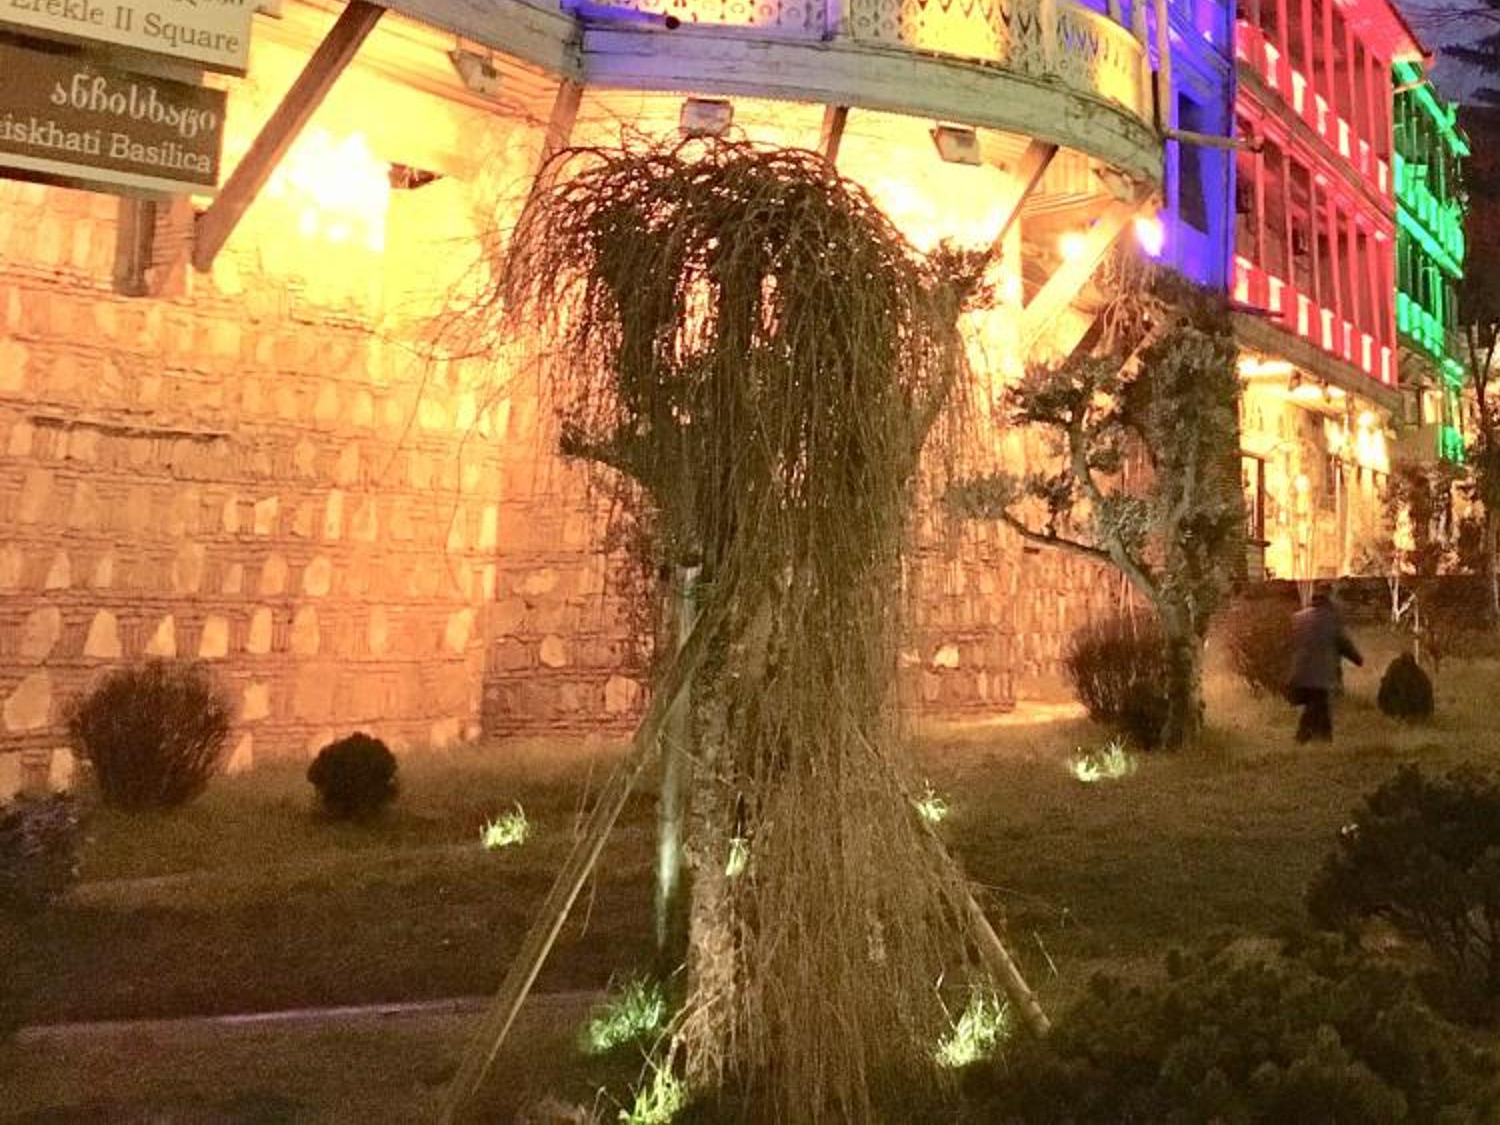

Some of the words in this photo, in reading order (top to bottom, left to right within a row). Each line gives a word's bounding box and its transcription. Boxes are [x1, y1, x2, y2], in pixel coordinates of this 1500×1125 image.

[143, 12, 239, 53] Square
[0, 113, 100, 156] iskhati
[110, 132, 211, 173] Basilica
